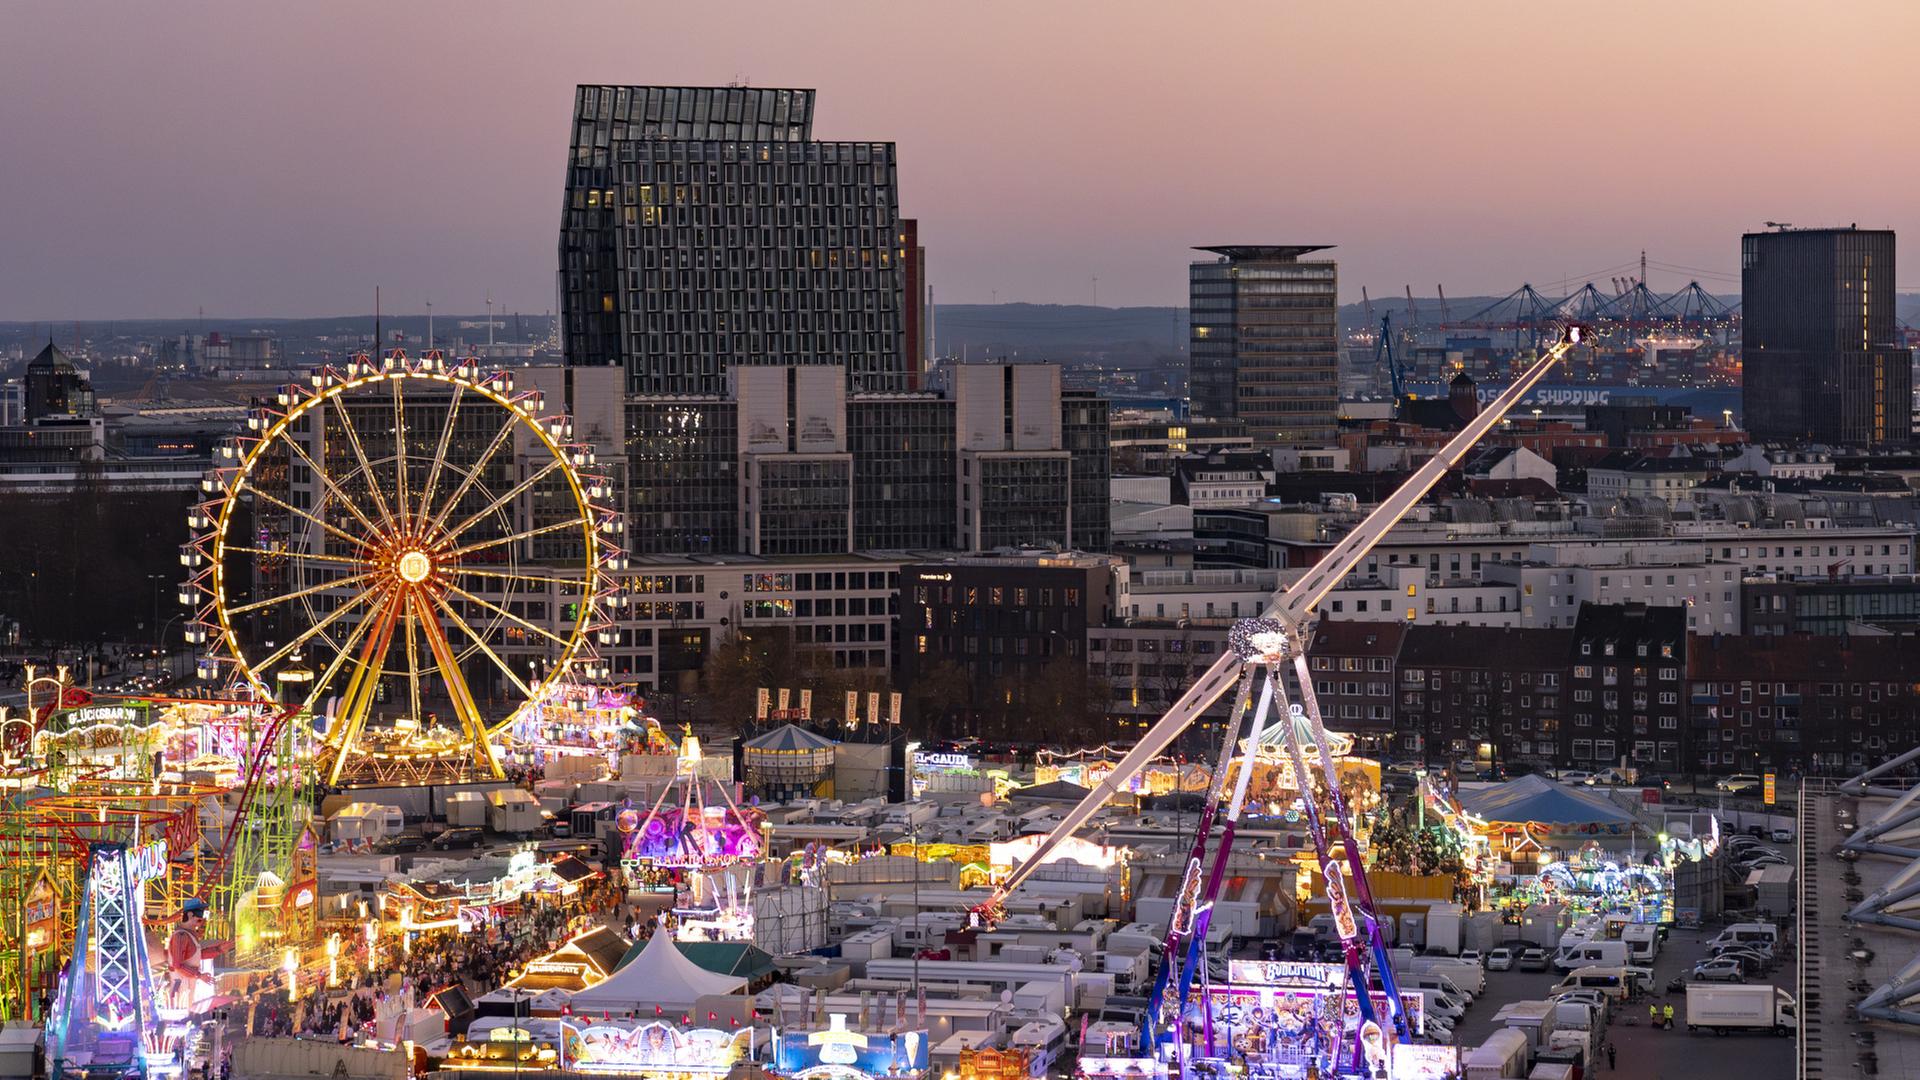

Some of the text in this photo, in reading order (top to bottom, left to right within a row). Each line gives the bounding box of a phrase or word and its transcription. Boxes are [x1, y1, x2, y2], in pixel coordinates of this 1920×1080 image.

[1537, 389, 1610, 403] SHIPPING
[125, 839, 167, 882] MAUS
[1266, 963, 1326, 982] EVOLUTION
